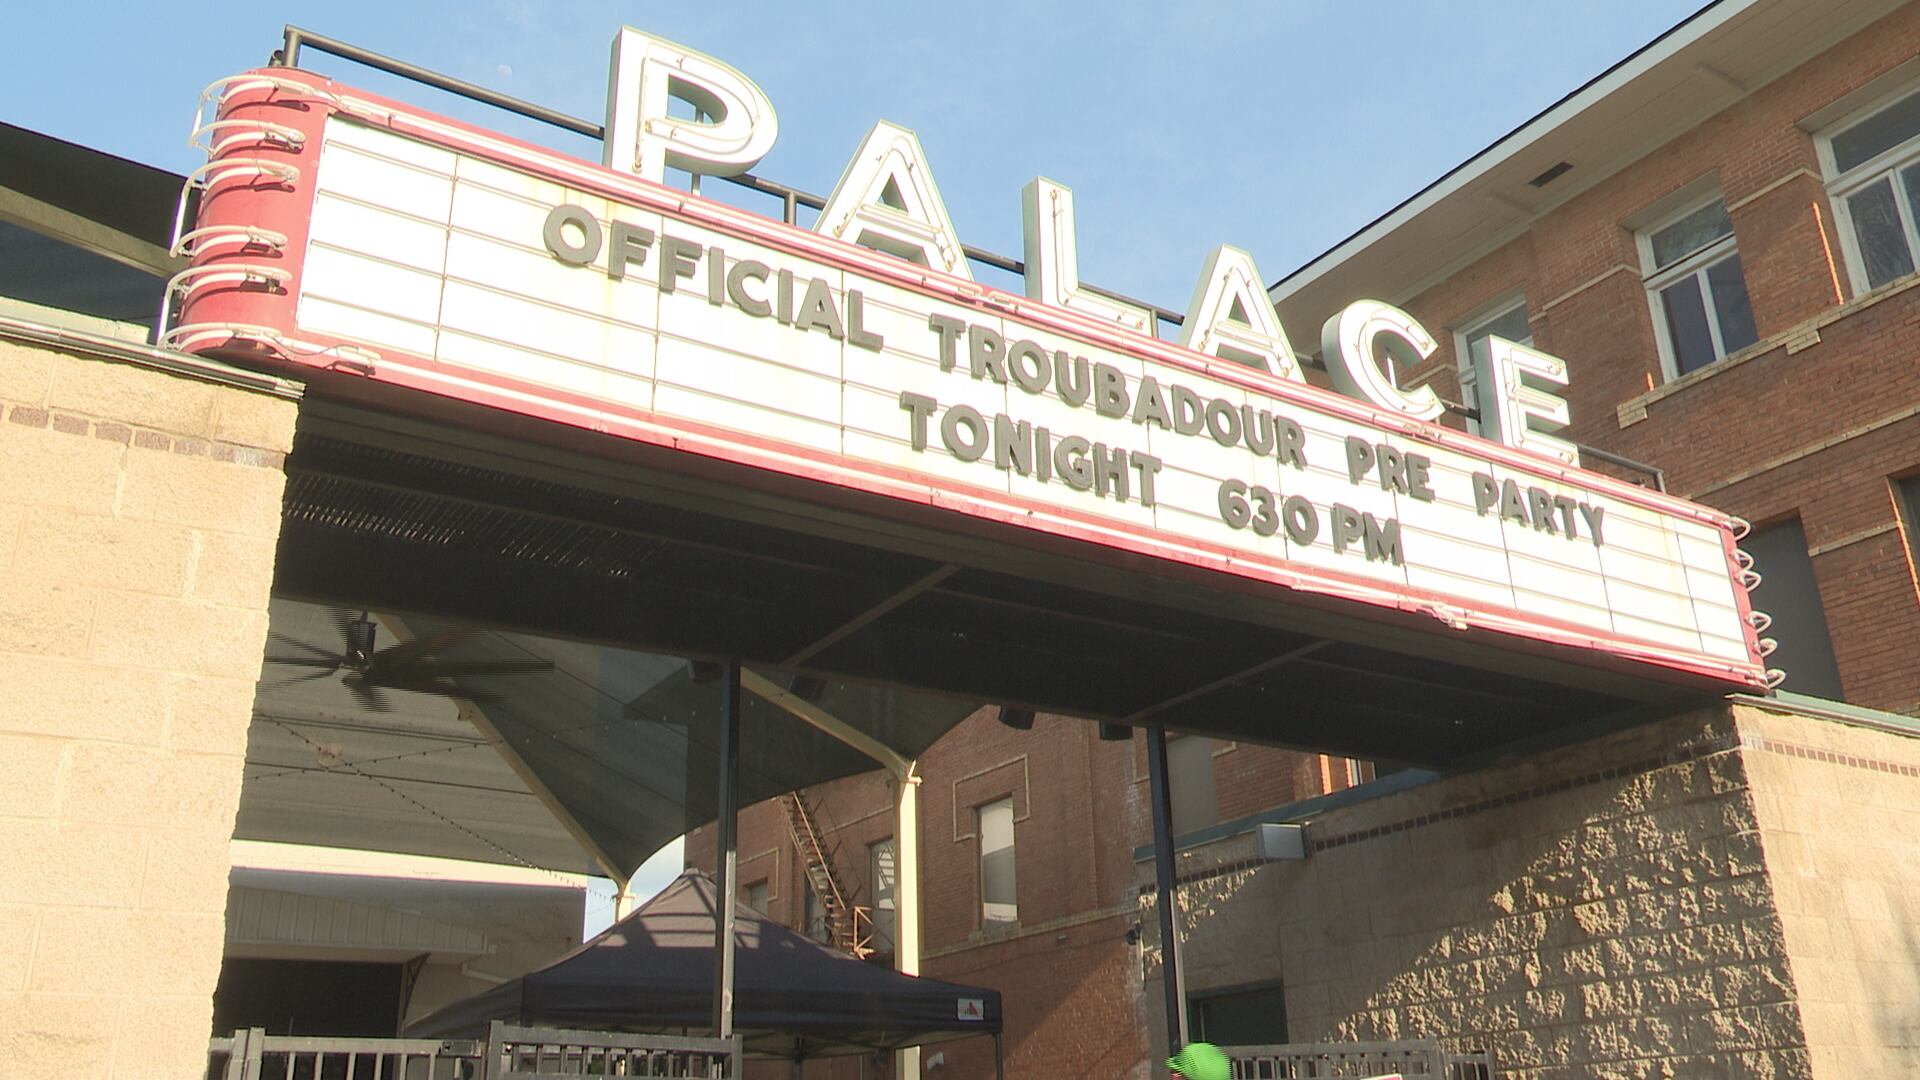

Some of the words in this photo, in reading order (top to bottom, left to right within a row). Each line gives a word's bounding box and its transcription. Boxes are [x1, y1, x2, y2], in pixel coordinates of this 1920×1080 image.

[542, 203, 884, 352] OFFICIAL
[928, 312, 1307, 470] TROUBADOUR
[1345, 435, 1435, 503] PRE
[1472, 470, 1605, 547] PARTY
[604, 25, 1581, 468] PALACE
[900, 390, 1162, 508] TONIGHT
[1218, 478, 1320, 547] 630
[1330, 502, 1405, 566] PM
